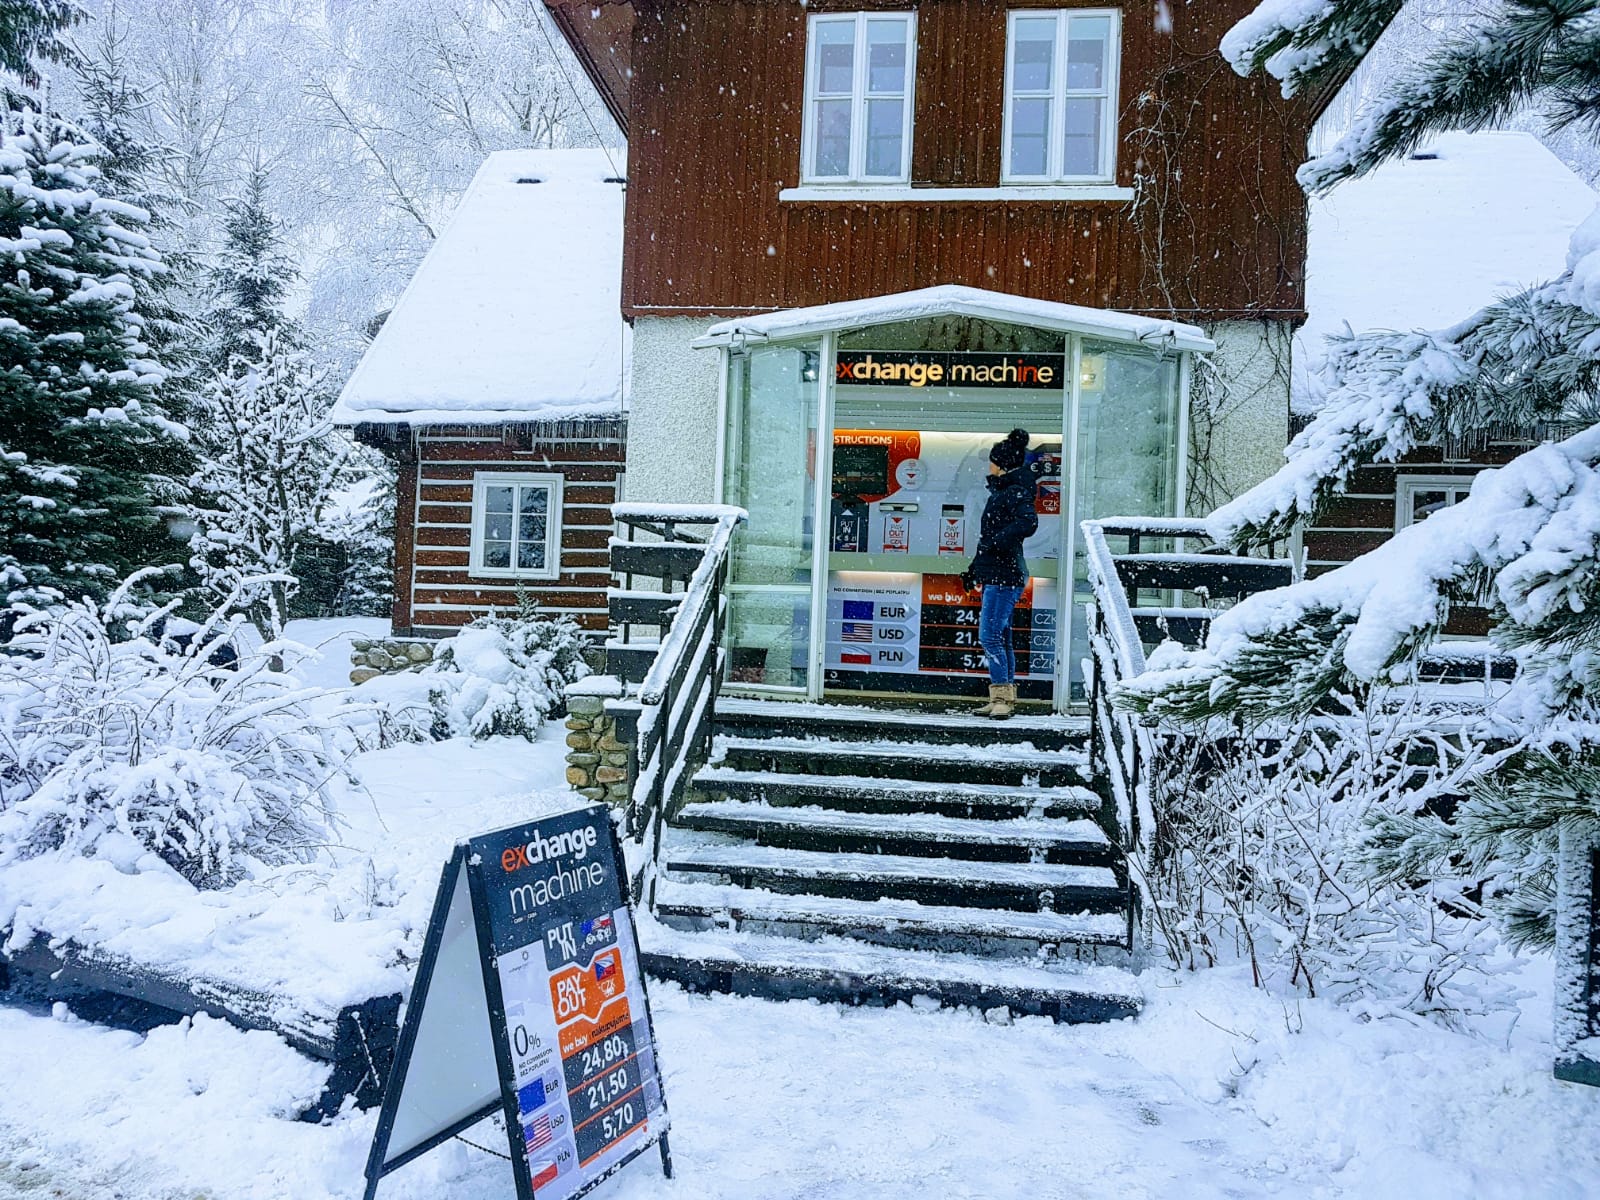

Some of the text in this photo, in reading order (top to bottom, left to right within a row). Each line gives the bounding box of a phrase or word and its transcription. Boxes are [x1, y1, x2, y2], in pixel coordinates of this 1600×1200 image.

[951, 357, 1054, 383] machine
[834, 435, 893, 445] STRUCTIONS
[1043, 461, 1052, 473] $
[927, 593, 943, 601] we
[945, 592, 963, 603] buy
[880, 607, 906, 618] EUR
[956, 609, 982, 625] 24,
[879, 629, 904, 640] USD
[955, 631, 982, 646] 21,
[879, 650, 903, 662] PLN
[963, 654, 986, 669] 5,7
[501, 825, 598, 873] exchange
[509, 860, 604, 914] machine
[547, 921, 574, 950] PUT
[561, 940, 577, 960] IN
[556, 972, 582, 998] PAY
[557, 987, 586, 1018] OUT
[513, 1023, 542, 1057] 0%
[562, 1041, 574, 1054] we
[574, 1033, 588, 1047] buy
[545, 1034, 622, 1094] EUR 24,80
[550, 1114, 565, 1129] USD
[587, 1068, 628, 1110] 21,50
[557, 1149, 571, 1165] PLN
[601, 1102, 634, 1139] 5,70
